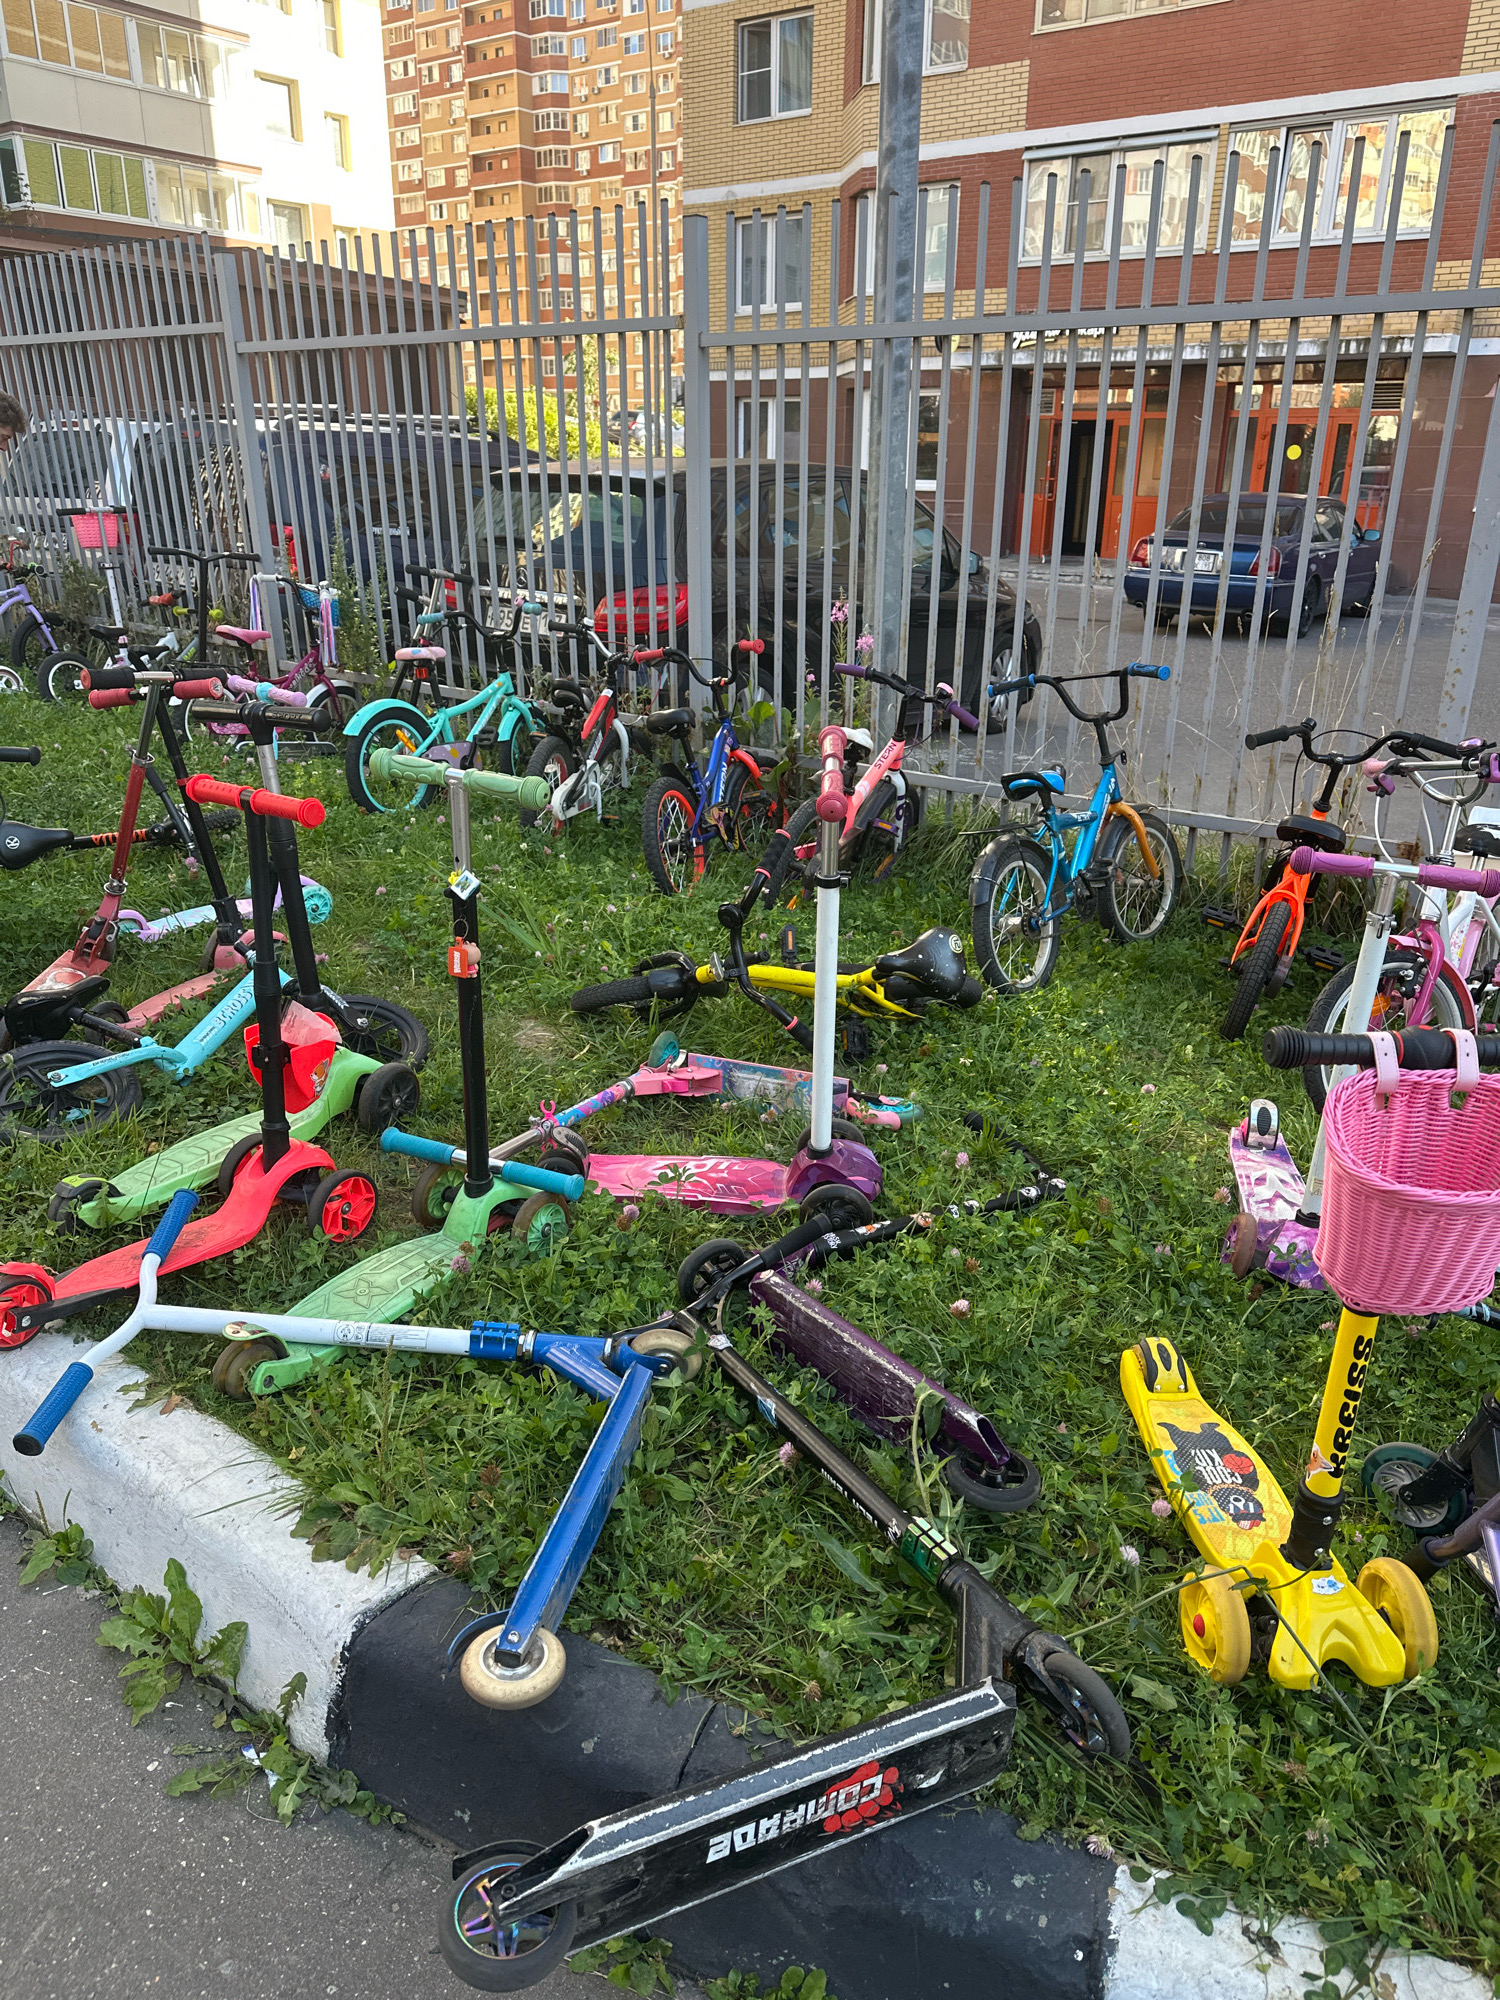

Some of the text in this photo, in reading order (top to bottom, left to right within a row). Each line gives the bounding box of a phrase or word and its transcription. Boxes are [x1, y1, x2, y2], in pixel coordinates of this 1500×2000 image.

[874, 742, 897, 769] STERN
[1328, 1334, 1374, 1479] KREISS
[1195, 1465, 1243, 1485] COOL
[706, 1773, 884, 1864] COMRADE
